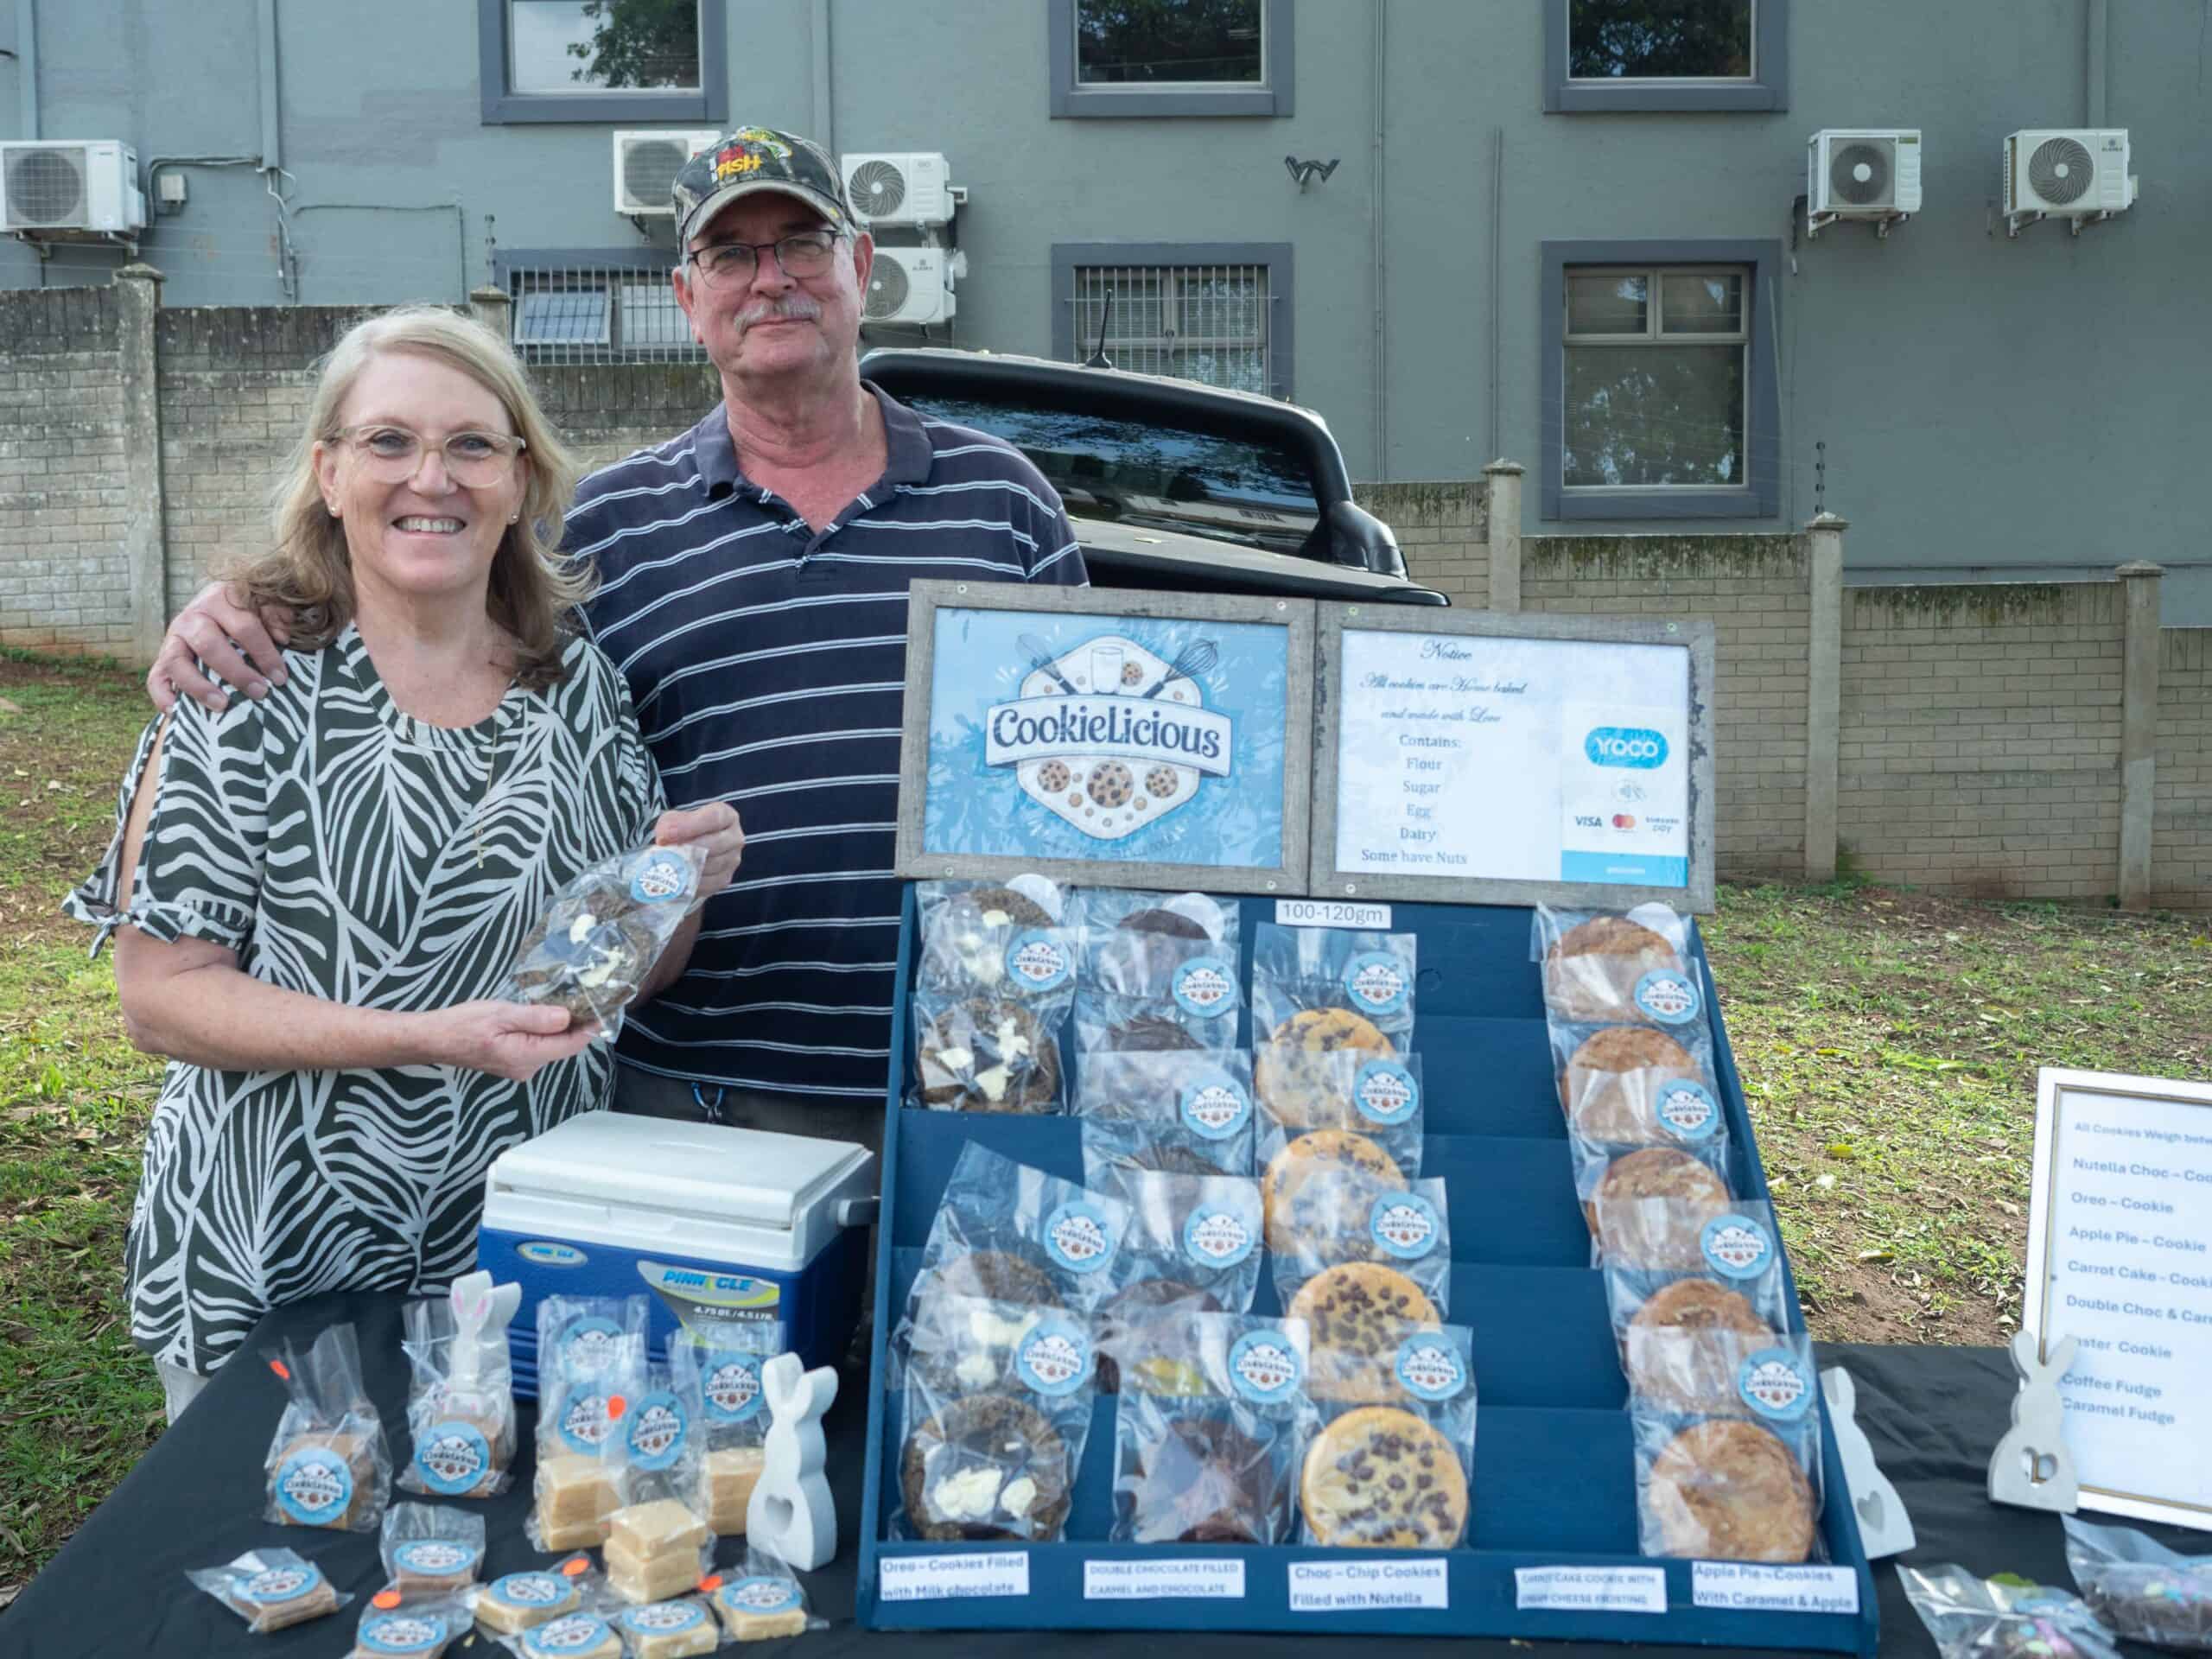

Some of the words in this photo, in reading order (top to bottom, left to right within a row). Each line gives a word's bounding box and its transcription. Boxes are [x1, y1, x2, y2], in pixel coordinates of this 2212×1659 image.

[1421, 640, 1472, 660] Notice
[1468, 704, 1501, 723] Love
[994, 704, 1220, 759] CookieLicious
[1399, 734, 1461, 748] Contains:
[1407, 757, 1442, 771] Flour
[1402, 779, 1440, 795] Sugar
[1407, 803, 1432, 820] Egg
[1575, 816, 1603, 828] VISA
[1400, 827, 1437, 842] Dairy
[1362, 849, 1397, 862] Some
[1402, 850, 1433, 863] have
[1437, 851, 1467, 865] Nuts
[1284, 903, 1382, 925] 100-120gm
[2093, 1125, 2140, 1139] Cookies
[2144, 1129, 2181, 1143] Weigh
[2073, 1157, 2126, 1174] Nutella
[2130, 1164, 2169, 1179] Choc
[2071, 1192, 2107, 1206] Oreo
[2121, 1197, 2174, 1214] Cookie
[2069, 1226, 2112, 1243] Apple
[2116, 1230, 2139, 1243] Pie
[2153, 1236, 2206, 1252] Cookie
[2068, 1260, 2115, 1276] Carrot
[2118, 1266, 2157, 1281] Cake
[2066, 1295, 2120, 1313] Double
[2123, 1302, 2164, 1319] Choc
[2167, 1307, 2178, 1319] &
[2119, 1341, 2171, 1358] Cookie
[2062, 1372, 2112, 1390] Coffee
[2116, 1380, 2162, 1398] Fudge
[2062, 1397, 2125, 1417] Caramel
[2129, 1406, 2176, 1426] Fudge
[883, 1561, 915, 1573] Oreo
[929, 1559, 982, 1571] Cookies
[987, 1555, 1024, 1568] Filled
[1090, 1564, 1132, 1574] DOUBLE
[1135, 1563, 1198, 1573] CHOCOLATE
[1202, 1562, 1238, 1573] FILLED
[1295, 1566, 1332, 1579] Choc
[1346, 1565, 1379, 1580] Chip
[1382, 1563, 1440, 1578] Cookies
[1694, 1564, 1735, 1579] Apple
[1739, 1566, 1760, 1577] Pie
[1774, 1568, 1833, 1581] Cookies
[883, 1586, 912, 1599] with
[915, 1584, 944, 1598] Milk
[947, 1582, 1015, 1597] chocolate
[1135, 1582, 1159, 1594] AND
[1161, 1580, 1225, 1594] CHOCOLATE
[1293, 1593, 1332, 1606] Filled
[1335, 1592, 1366, 1605] with
[1370, 1592, 1422, 1605] Nutella
[1695, 1591, 1728, 1605] With
[1732, 1592, 1794, 1607] Caramel
[1796, 1594, 1807, 1607] &
[1810, 1596, 1853, 1612] Apple
